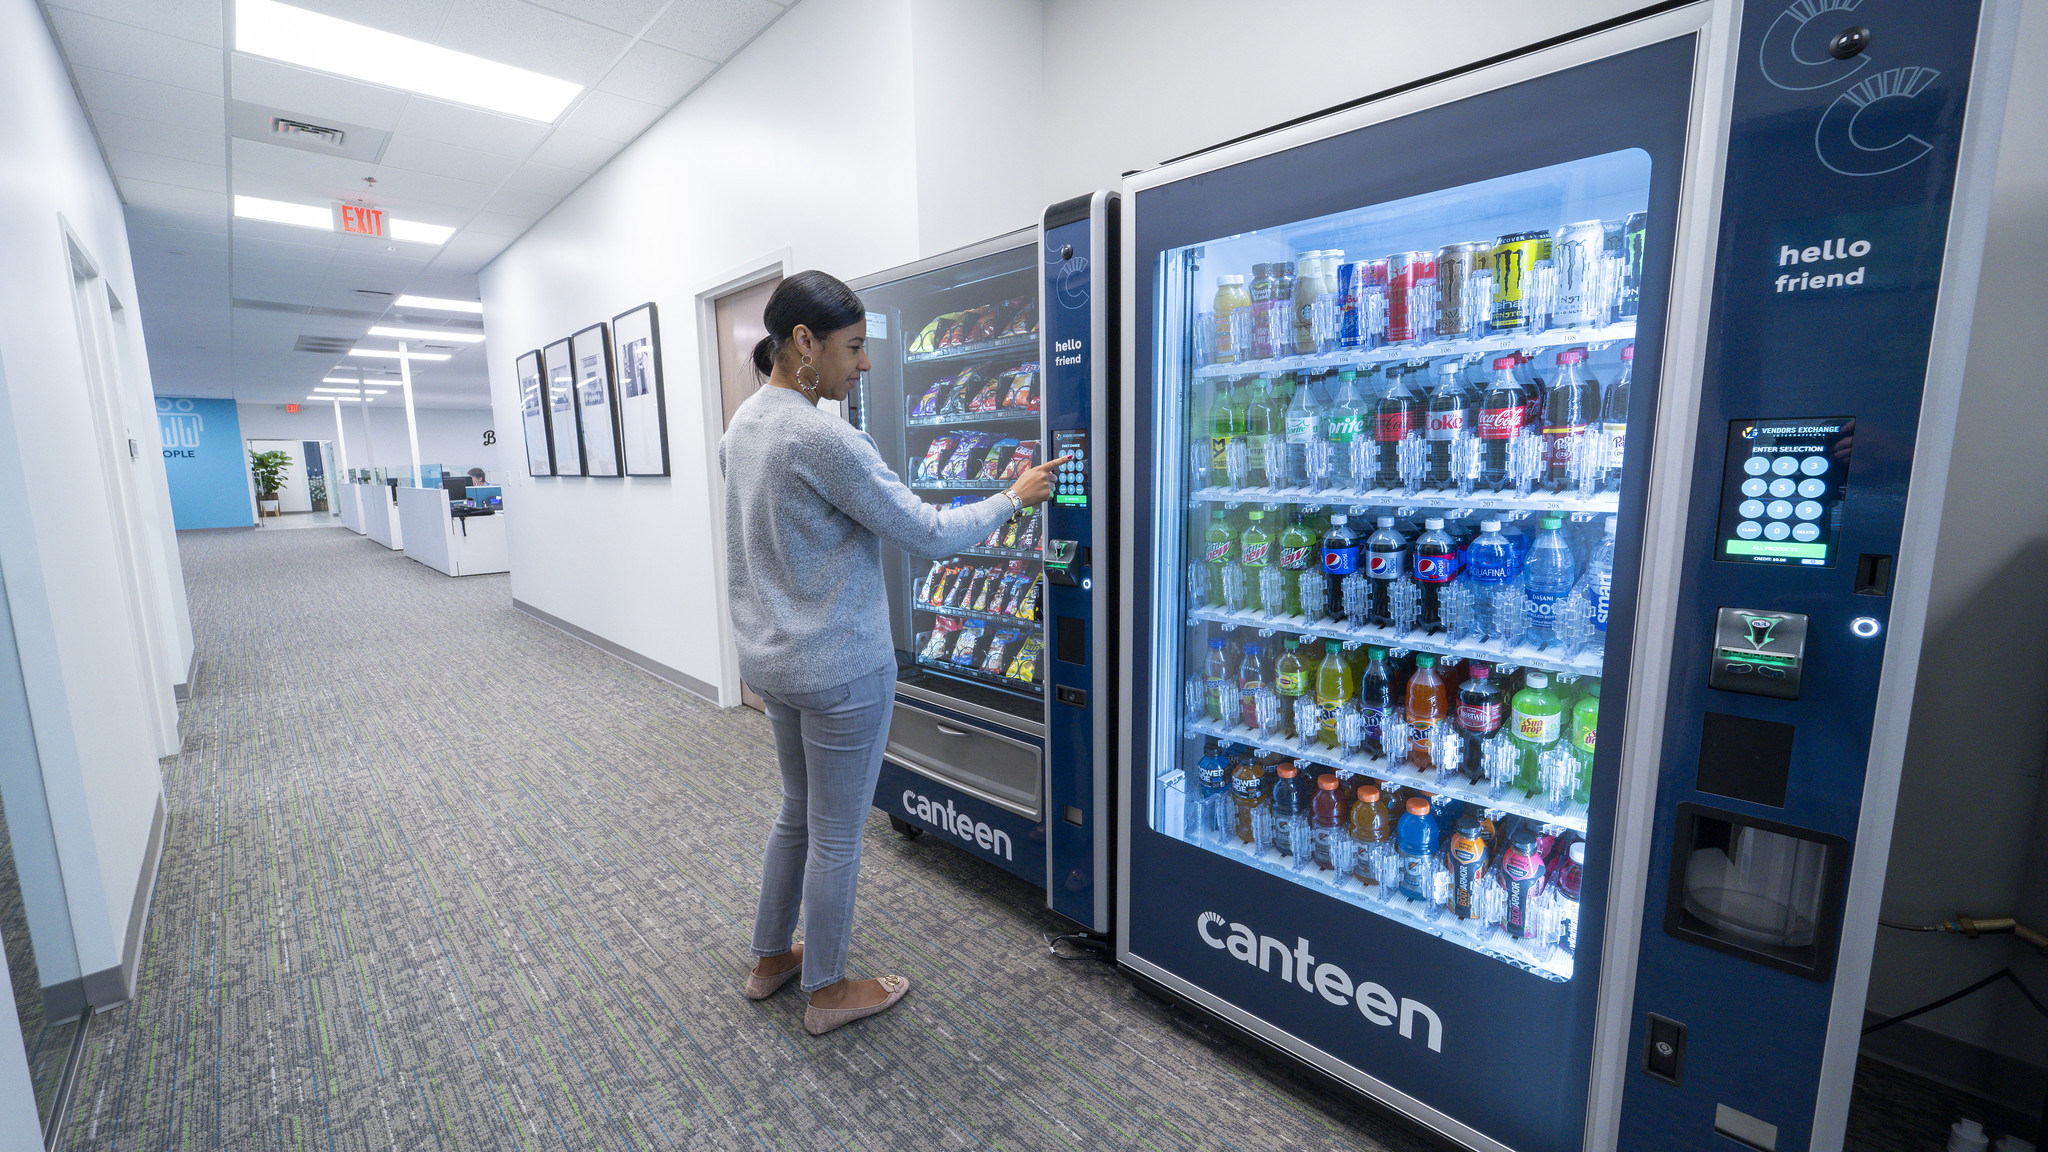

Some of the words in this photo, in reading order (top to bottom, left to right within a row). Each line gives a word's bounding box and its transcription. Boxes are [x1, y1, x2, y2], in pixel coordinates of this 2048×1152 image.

[341, 204, 383, 236] EXIT
[1779, 237, 1872, 266] hello
[1774, 266, 1866, 293] friend
[1055, 339, 1082, 352] hello
[1055, 354, 1081, 366] friend
[286, 404, 300, 413] EXIT
[1425, 414, 1463, 432] Coke
[1478, 409, 1525, 427] Coca-Cola
[162, 450, 196, 459] OPLE
[1810, 462, 1818, 470] 3
[1805, 506, 1813, 514] 9
[1469, 567, 1507, 577] AQUAFINA
[1520, 726, 1543, 735] Drop
[1523, 718, 1543, 728] Sun
[903, 789, 1013, 862] canteen
[1458, 865, 1468, 907] BODYARMOR
[1511, 881, 1521, 926] BODYARMOR
[1197, 911, 1443, 1054] canteen
